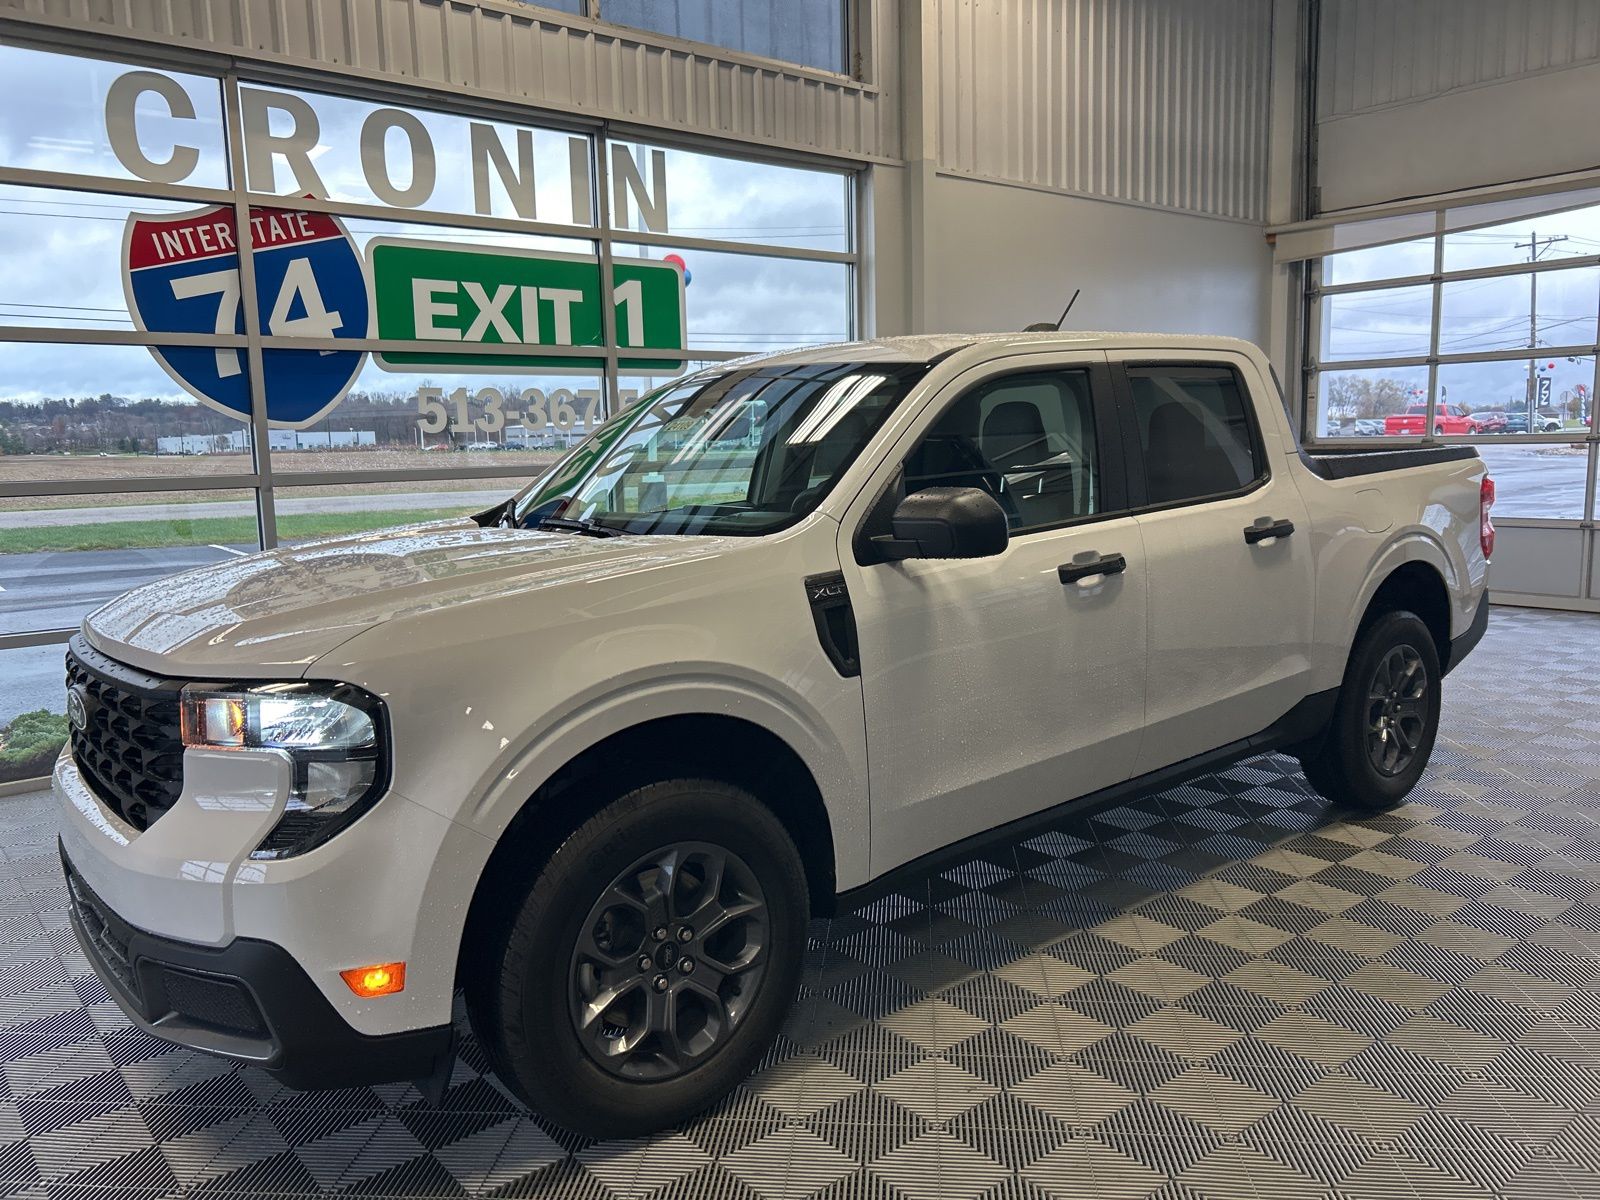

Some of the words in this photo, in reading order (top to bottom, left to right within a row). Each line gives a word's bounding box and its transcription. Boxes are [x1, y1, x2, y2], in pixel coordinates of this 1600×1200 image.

[105, 70, 668, 233] CRONIN
[151, 211, 316, 260] INTERTATE
[169, 257, 344, 378] 74
[411, 277, 583, 346] EXIT
[613, 279, 645, 347] 1
